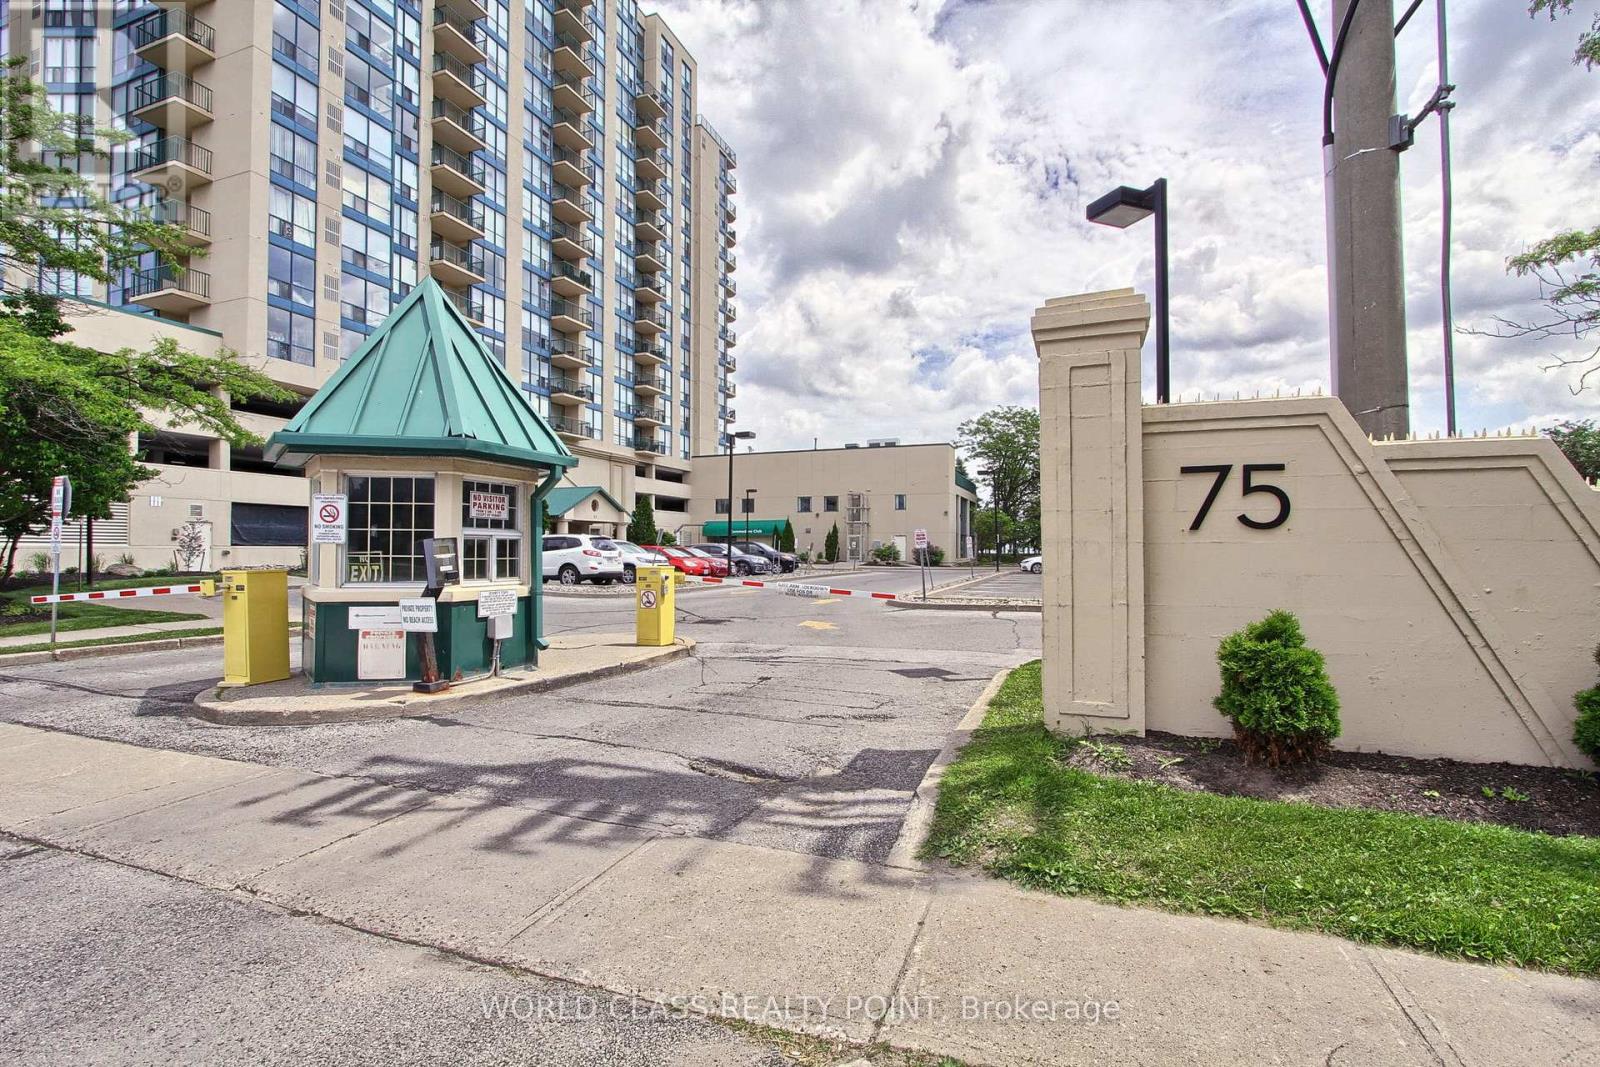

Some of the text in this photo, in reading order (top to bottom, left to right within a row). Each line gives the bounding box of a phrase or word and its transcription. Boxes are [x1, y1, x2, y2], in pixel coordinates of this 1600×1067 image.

[483, 495, 506, 504] VISITOR
[1180, 463, 1291, 531] 75
[472, 502, 505, 511] PARKING
[350, 565, 379, 582] EXIT
[415, 604, 433, 613] PROPERTY
